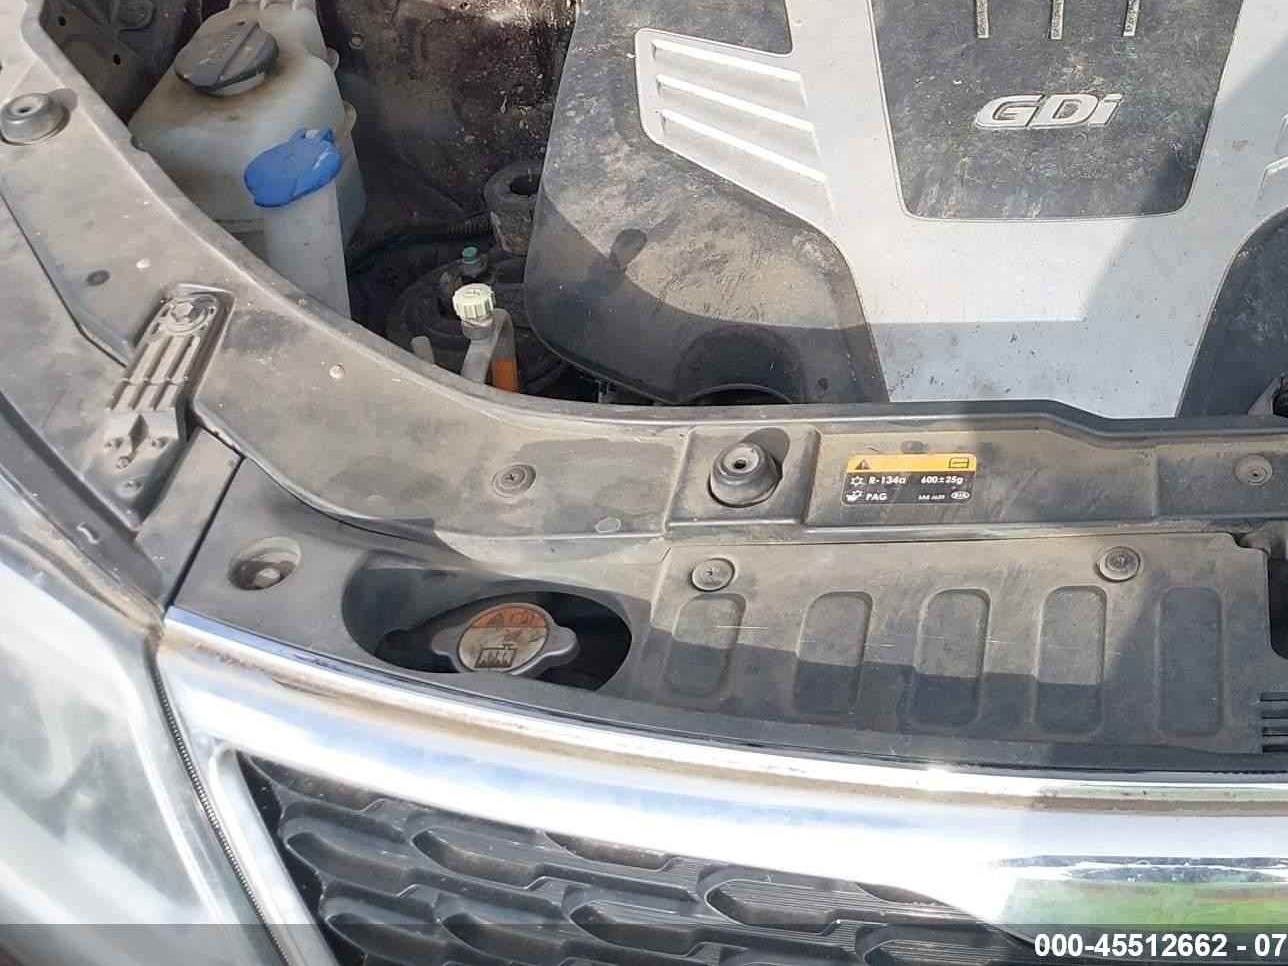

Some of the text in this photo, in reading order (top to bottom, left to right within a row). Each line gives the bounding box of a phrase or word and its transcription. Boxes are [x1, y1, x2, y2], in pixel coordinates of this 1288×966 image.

[974, 93, 1124, 129] GDi
[868, 475, 906, 484] R-134a
[865, 493, 888, 501] PAG
